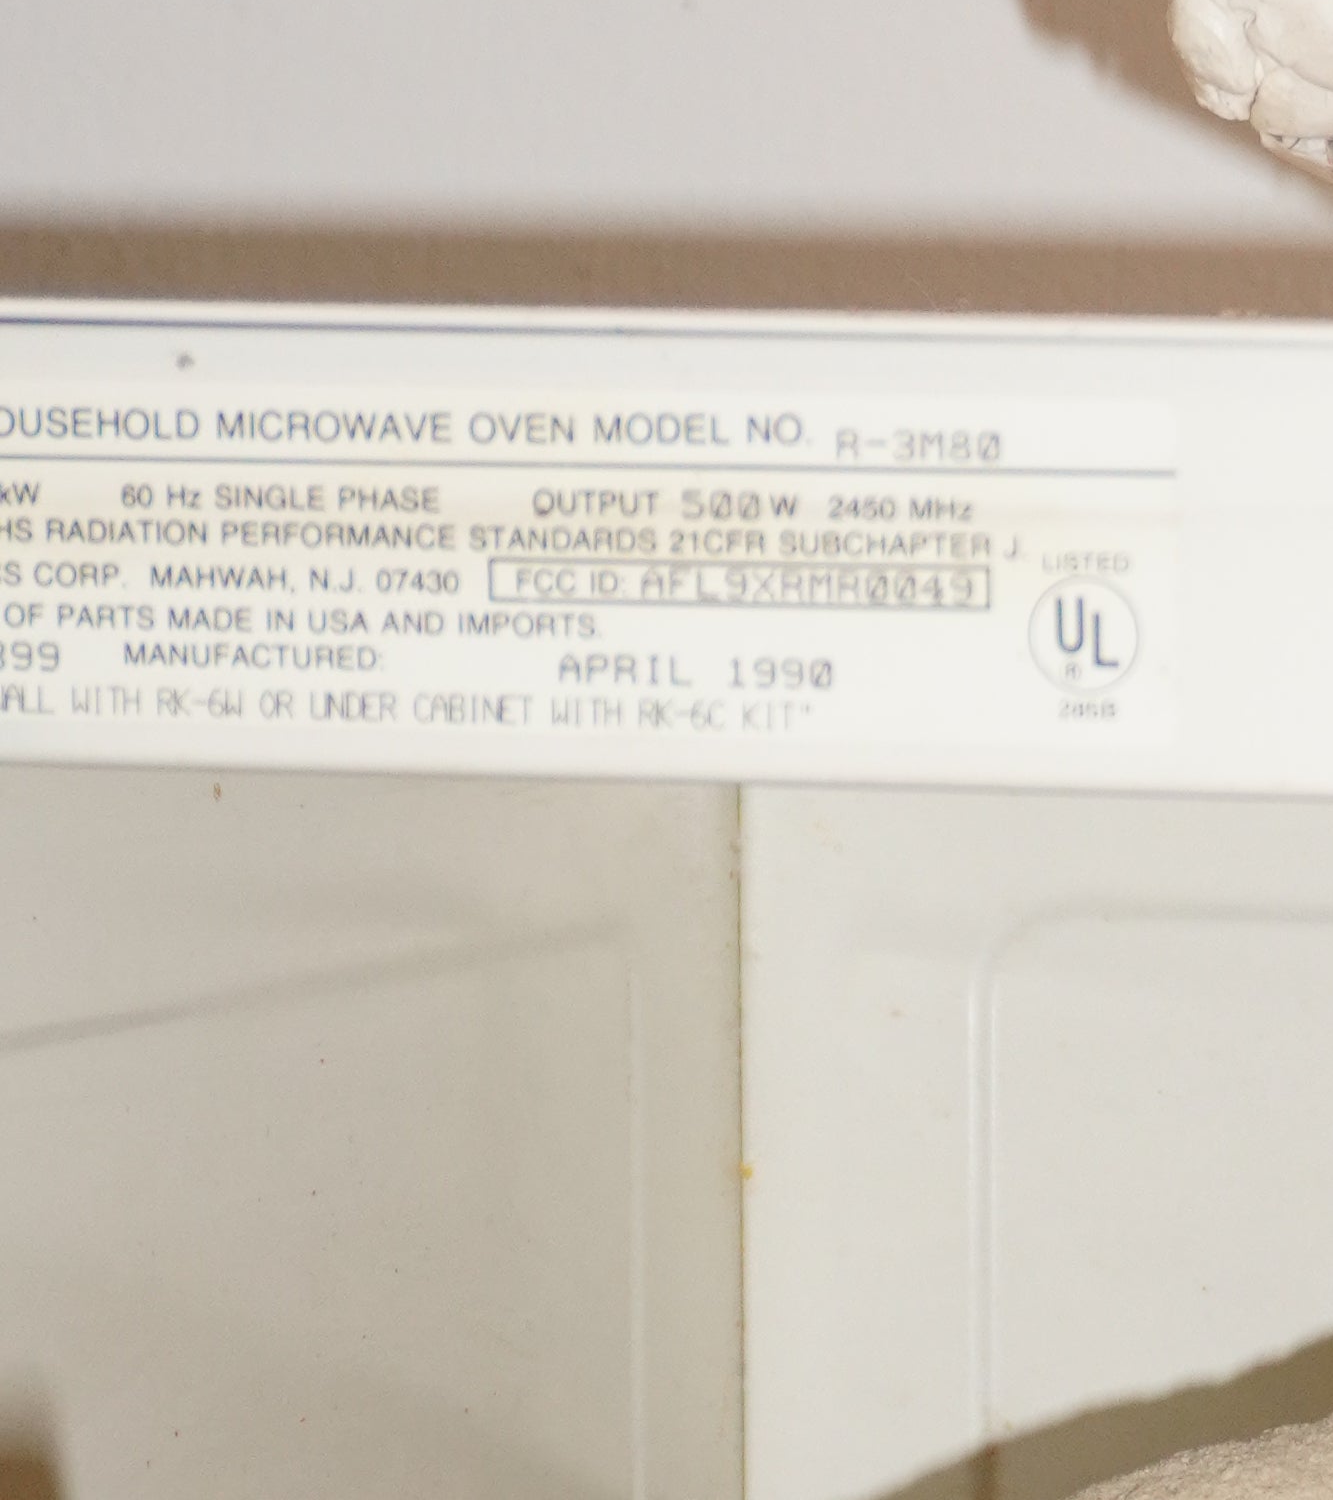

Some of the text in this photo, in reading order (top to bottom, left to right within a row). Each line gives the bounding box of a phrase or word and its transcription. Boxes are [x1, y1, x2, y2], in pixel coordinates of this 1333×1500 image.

[0, 407, 199, 441] OUSEHOLD
[216, 410, 453, 444] MICROWAVE
[469, 412, 575, 445] OVEN
[594, 413, 729, 447] MODEL
[747, 413, 812, 447] NO.
[121, 484, 153, 509] 60
[167, 486, 200, 511] Hz
[214, 486, 323, 512] SINGLE
[338, 488, 440, 513] PHASE
[533, 490, 659, 517] OUTPUT
[828, 497, 895, 521] 2450
[909, 498, 973, 522] MHz
[46, 520, 207, 545] RADIATION
[221, 523, 455, 549] PERFORMANCE
[470, 526, 657, 552] STANDARDS
[670, 531, 766, 556] 21CFR
[779, 532, 991, 558] SUBCHAPTER
[0, 561, 22, 588] S
[34, 562, 127, 590] CORP.
[150, 566, 295, 595] MAHWAH,
[309, 566, 362, 592] N.J.
[377, 568, 459, 593] 07430
[516, 569, 576, 594] FCC
[1042, 552, 1130, 574] LISTED
[4, 602, 602, 640] OF PARTS MADE IN USA AND IMPORTS.
[1057, 596, 1119, 668] UL
[124, 642, 385, 672] MANUFACTURED:
[558, 653, 692, 687] APRIL
[730, 656, 835, 690] 1990
[73, 685, 140, 716] WITH
[260, 689, 293, 718] OR
[309, 690, 396, 722] UNDER
[413, 693, 533, 726] CABINET
[552, 697, 620, 727] WITH
